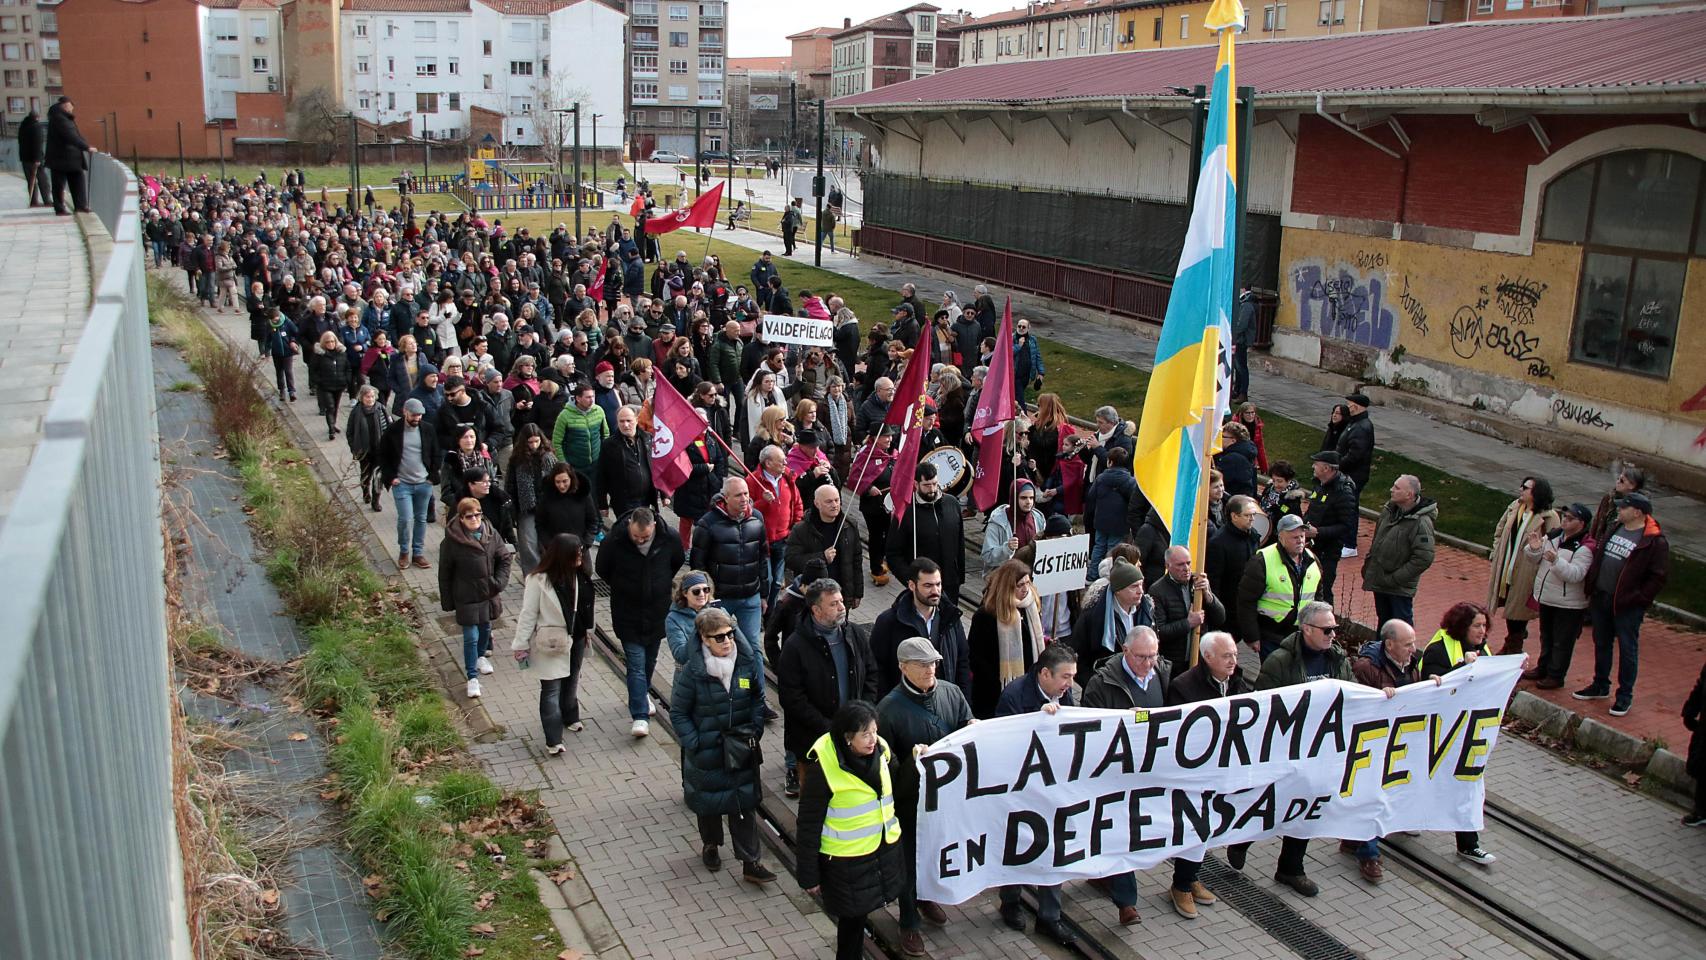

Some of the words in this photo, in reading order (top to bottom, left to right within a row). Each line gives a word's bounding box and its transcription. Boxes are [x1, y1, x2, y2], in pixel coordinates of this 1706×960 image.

[765, 320, 833, 340] VALDEPIÉLAGO
[1033, 551, 1088, 575] CISTIERNA
[920, 687, 1345, 812] PLATAFORMA
[939, 833, 987, 879] EN
[1002, 783, 1275, 867] DEFENSA
[1282, 795, 1332, 822] DE
[1339, 707, 1502, 798] FEVE
